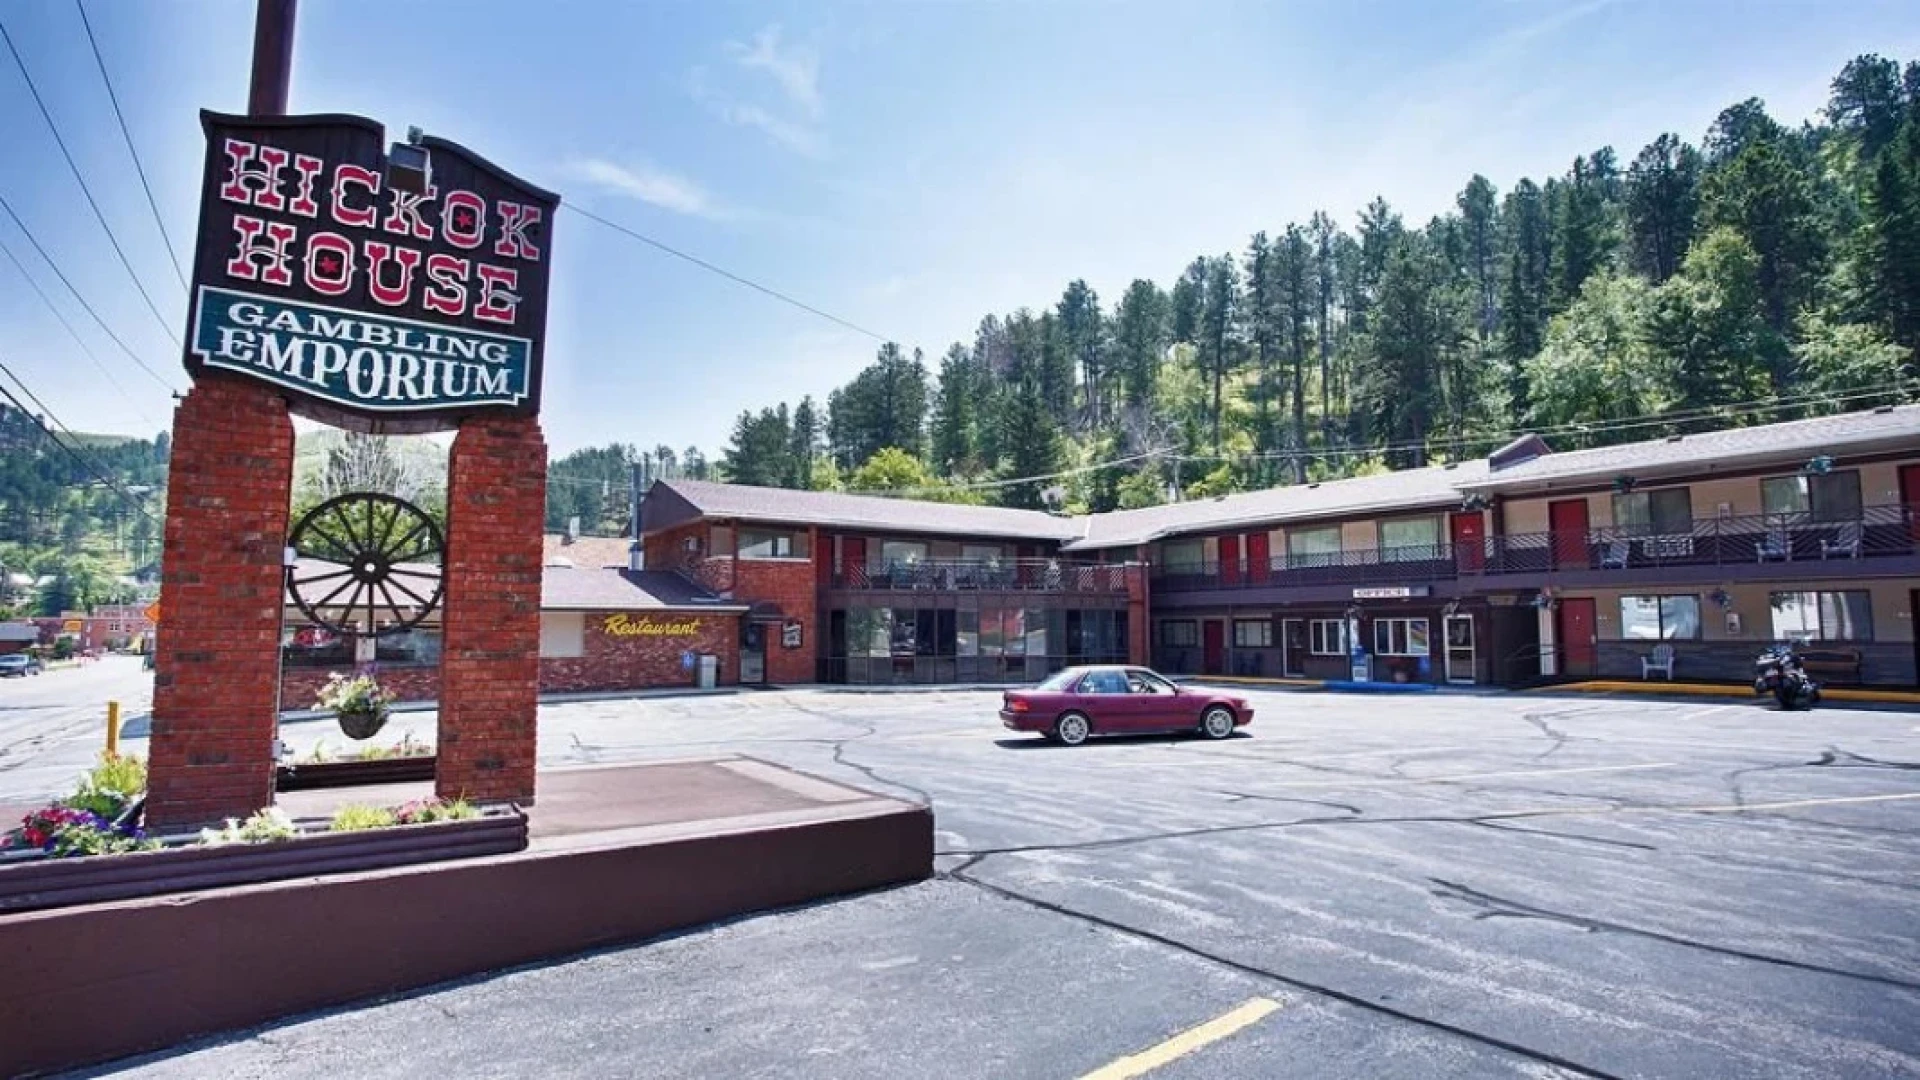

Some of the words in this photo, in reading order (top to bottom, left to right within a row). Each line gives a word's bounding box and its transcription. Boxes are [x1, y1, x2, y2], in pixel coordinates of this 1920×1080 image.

[220, 138, 542, 261] HICKOK
[226, 214, 522, 325] HOUSE
[215, 326, 512, 401] EMPORIUM
[228, 303, 509, 364] GAMBLING
[604, 613, 700, 635] Restaurant
